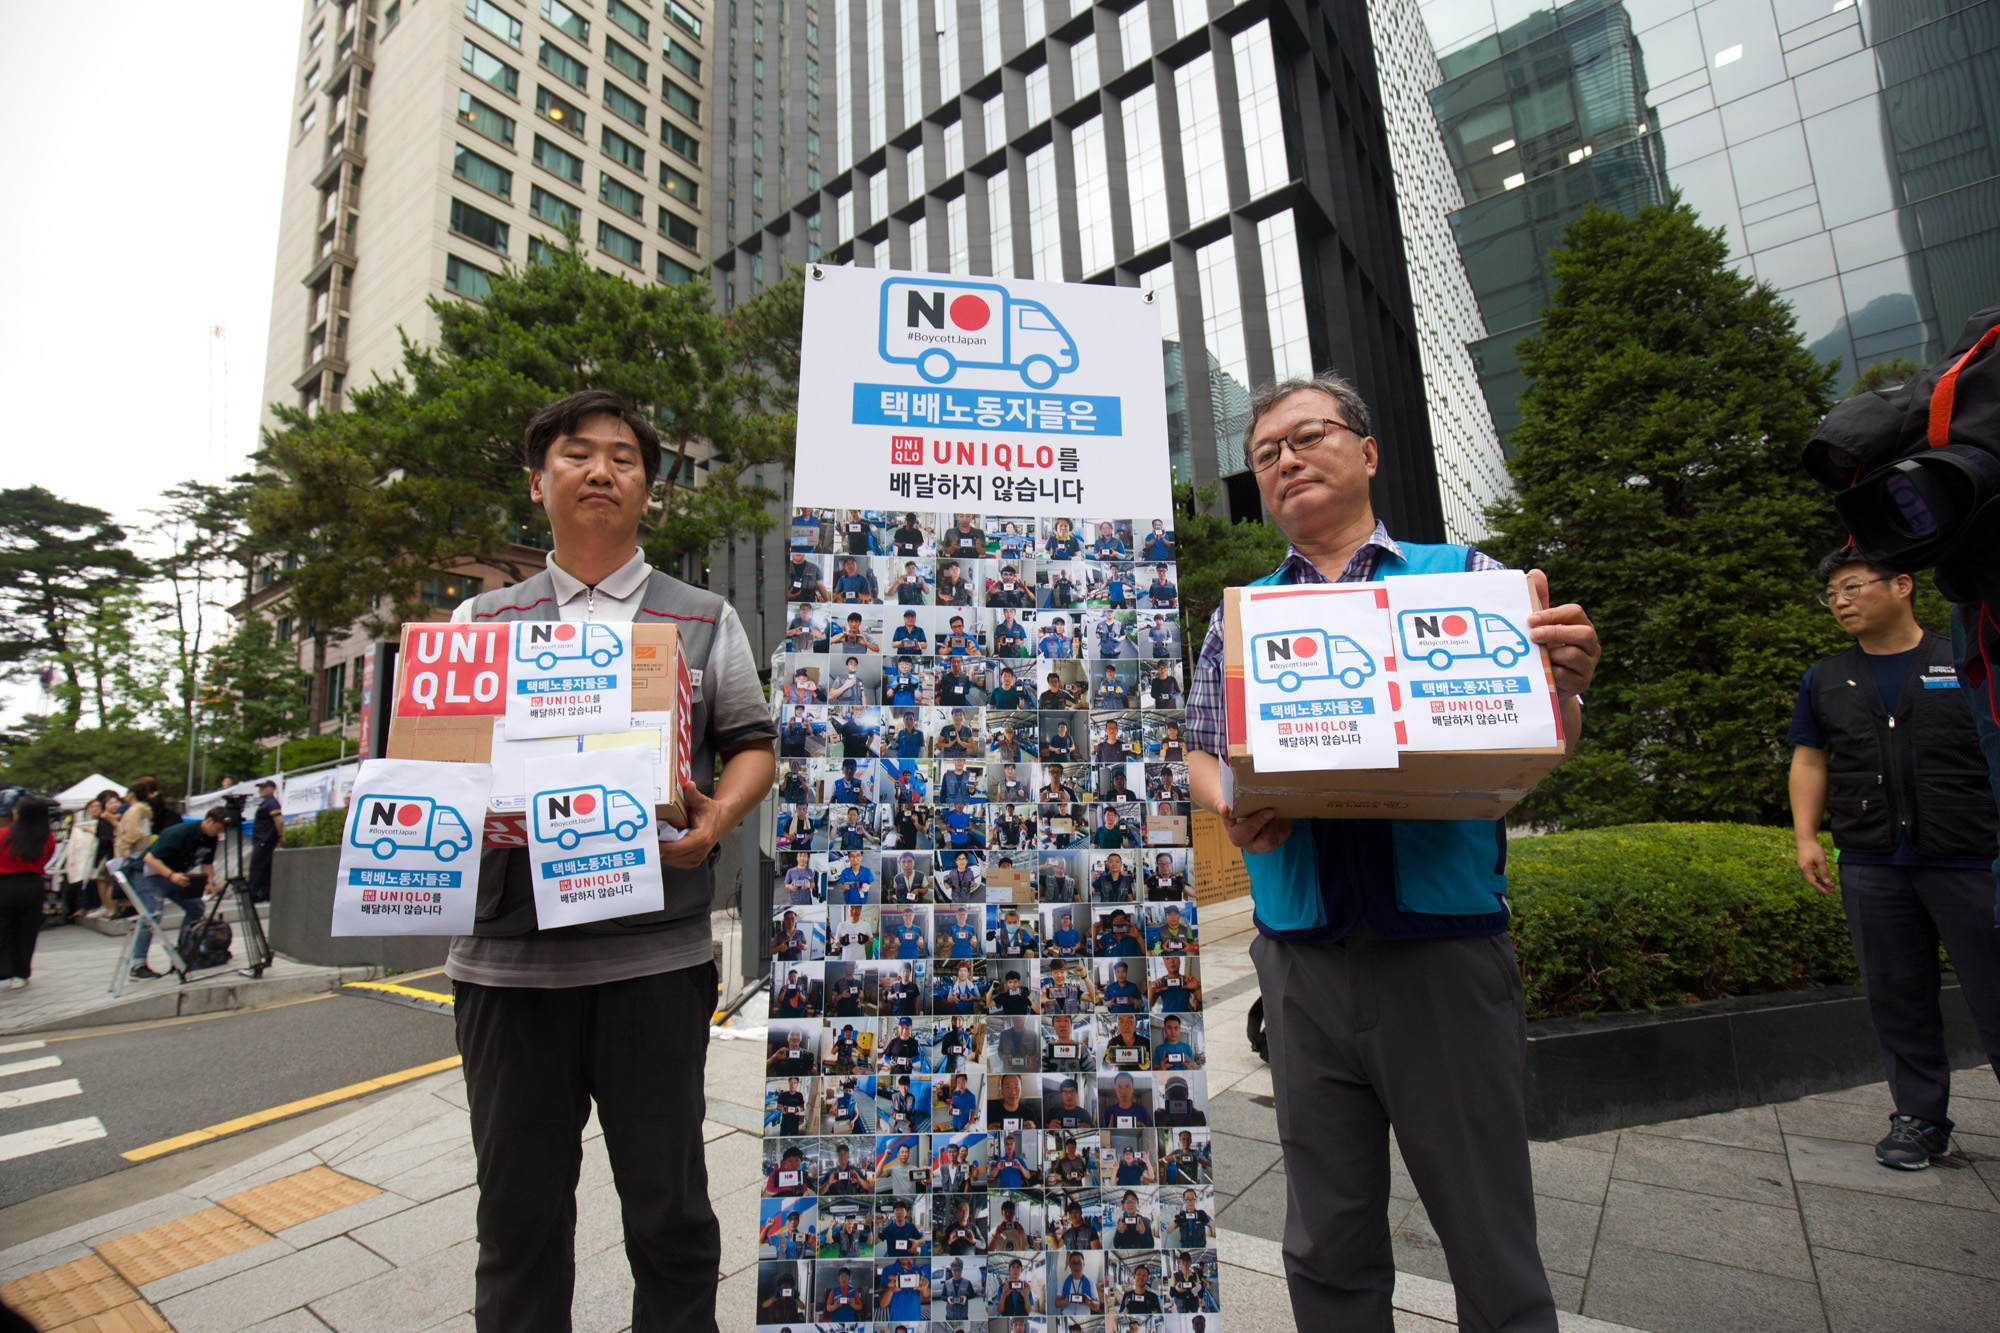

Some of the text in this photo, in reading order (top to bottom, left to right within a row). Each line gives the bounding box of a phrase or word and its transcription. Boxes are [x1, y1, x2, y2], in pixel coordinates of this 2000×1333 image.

[907, 332, 987, 345] #BoycottJapan
[880, 391, 1097, 431] 택배노동자들은
[895, 439, 918, 451] UNI
[895, 451, 920, 463] QLO
[889, 472, 1084, 504] 배달하지 않습니다
[417, 631, 495, 664] UNI
[1269, 661, 1318, 669] #BoycottJapan
[412, 670, 500, 710] QLO
[526, 677, 608, 692] 택배노동자들은
[1421, 679, 1519, 695] 택배노동자들은
[530, 705, 602, 718] 배달하지 않습니다
[1270, 700, 1364, 718] 택배노동자들은
[1432, 713, 1518, 726] 배달하지 않습니다
[1279, 733, 1361, 748] 배달하지 않습니다
[550, 817, 596, 828] #BoycottJapan
[369, 828, 417, 836] #BoycottJapan
[552, 852, 636, 875] 택배노동자들은
[360, 871, 451, 886] 택배노동자들은
[560, 883, 633, 904] 배달하지 않습니다
[361, 904, 442, 915] 배달하지 않습니다
